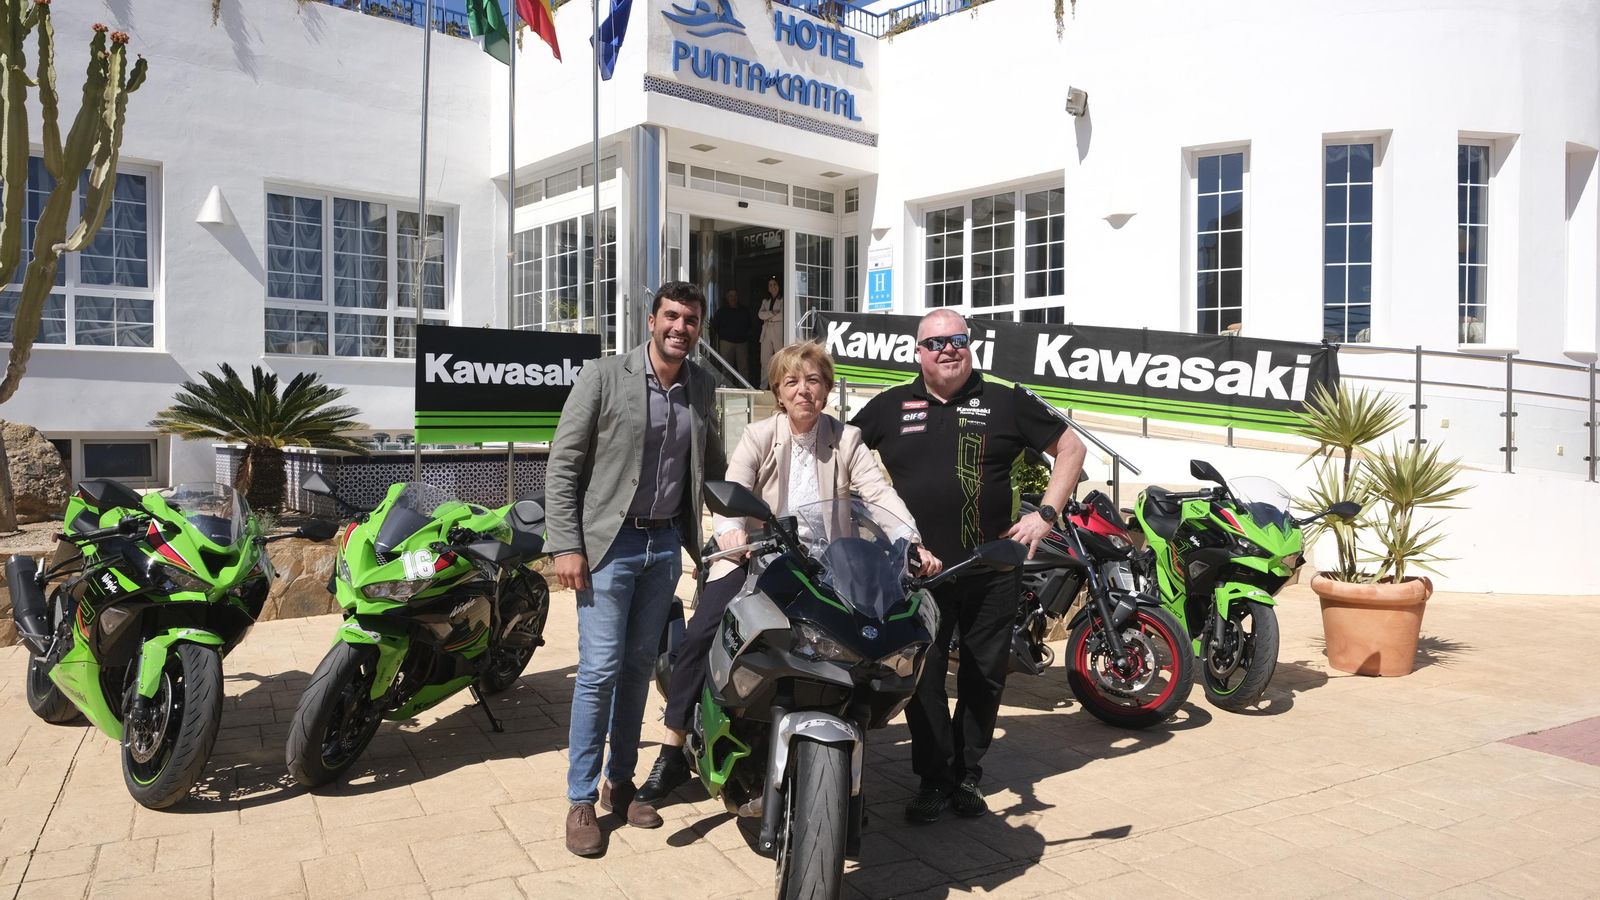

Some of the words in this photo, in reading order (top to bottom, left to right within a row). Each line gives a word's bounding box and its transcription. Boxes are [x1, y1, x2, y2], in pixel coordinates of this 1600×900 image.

[774, 10, 864, 69] HOTEL
[672, 40, 768, 95] PUNTA
[775, 73, 862, 121] CANTAL
[874, 272, 886, 292] H
[826, 321, 996, 370] Kawaki
[425, 352, 597, 386] Kawasak
[1033, 333, 1312, 402] Kawasaki
[903, 413, 918, 421] elf
[400, 548, 436, 581] 16
[101, 572, 118, 595] Ninja
